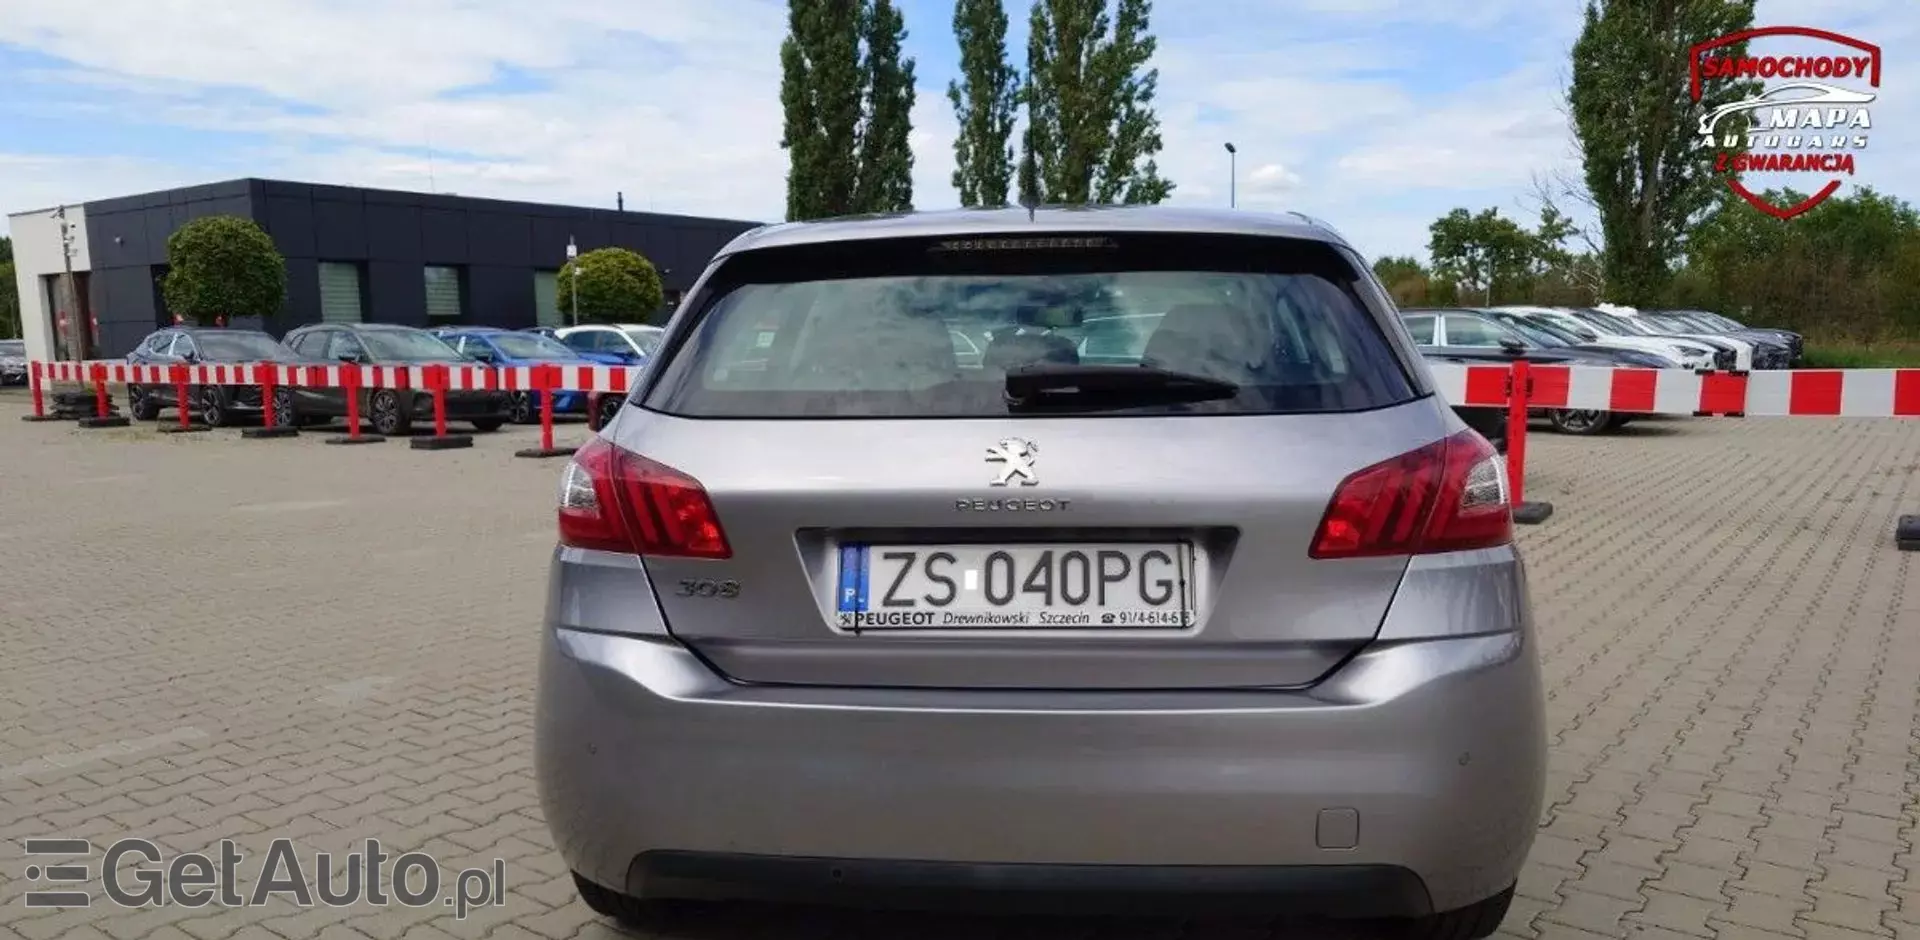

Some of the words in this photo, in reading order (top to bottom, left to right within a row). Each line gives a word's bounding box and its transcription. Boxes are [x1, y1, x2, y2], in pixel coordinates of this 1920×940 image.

[955, 498, 1071, 512] PEUGEOT
[882, 551, 957, 607] ZS
[984, 550, 1174, 607] 040PG
[675, 578, 741, 598] 308
[856, 612, 935, 625] PEUGEOT
[943, 612, 1029, 625] Drewnikowski
[1039, 612, 1089, 625] Szczecin
[1119, 611, 1190, 625] 91/4-614-6
